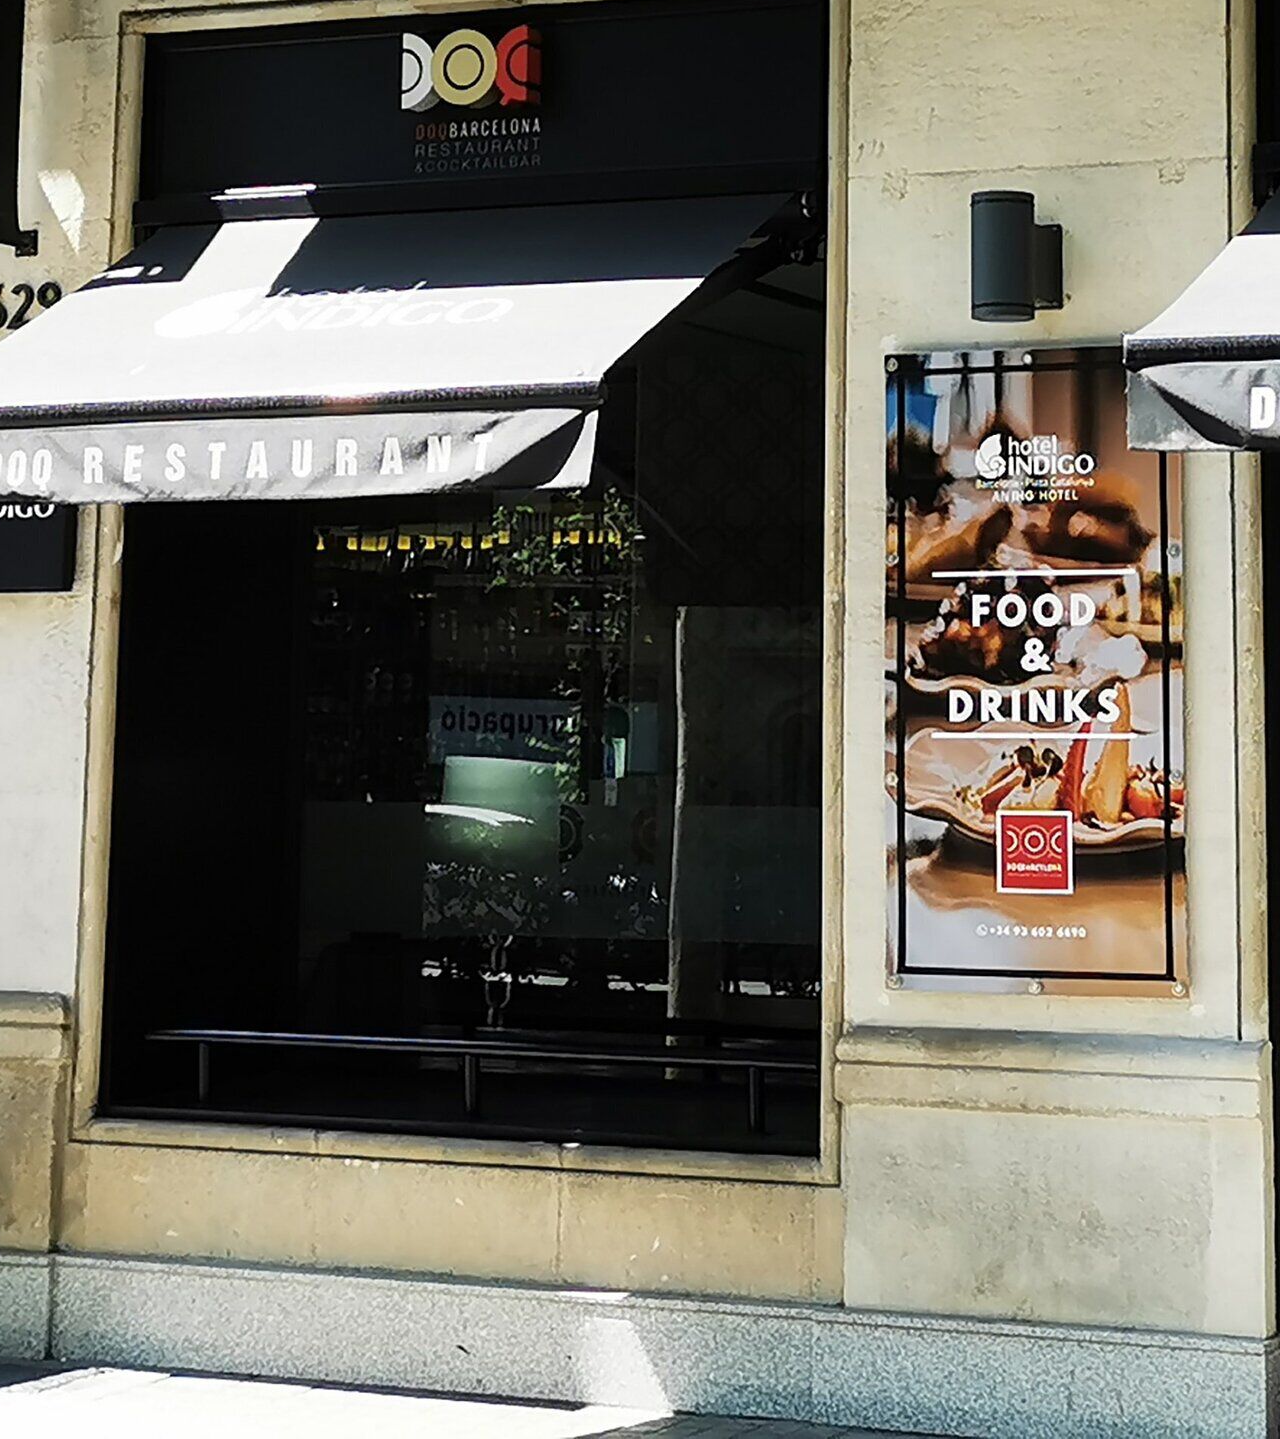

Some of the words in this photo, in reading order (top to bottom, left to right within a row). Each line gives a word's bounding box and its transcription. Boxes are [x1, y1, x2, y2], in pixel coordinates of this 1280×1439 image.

[414, 137, 542, 158] RESTAURANT
[225, 297, 515, 335] INDIGO
[83, 432, 493, 485] RESTAURANT
[1007, 433, 1058, 456] hotel
[1007, 452, 1096, 476] INDIGO
[1039, 489, 1079, 502] HOTEL
[971, 592, 1097, 628] FOOD
[1020, 637, 1054, 673] &
[948, 688, 1121, 724] DRINKS
